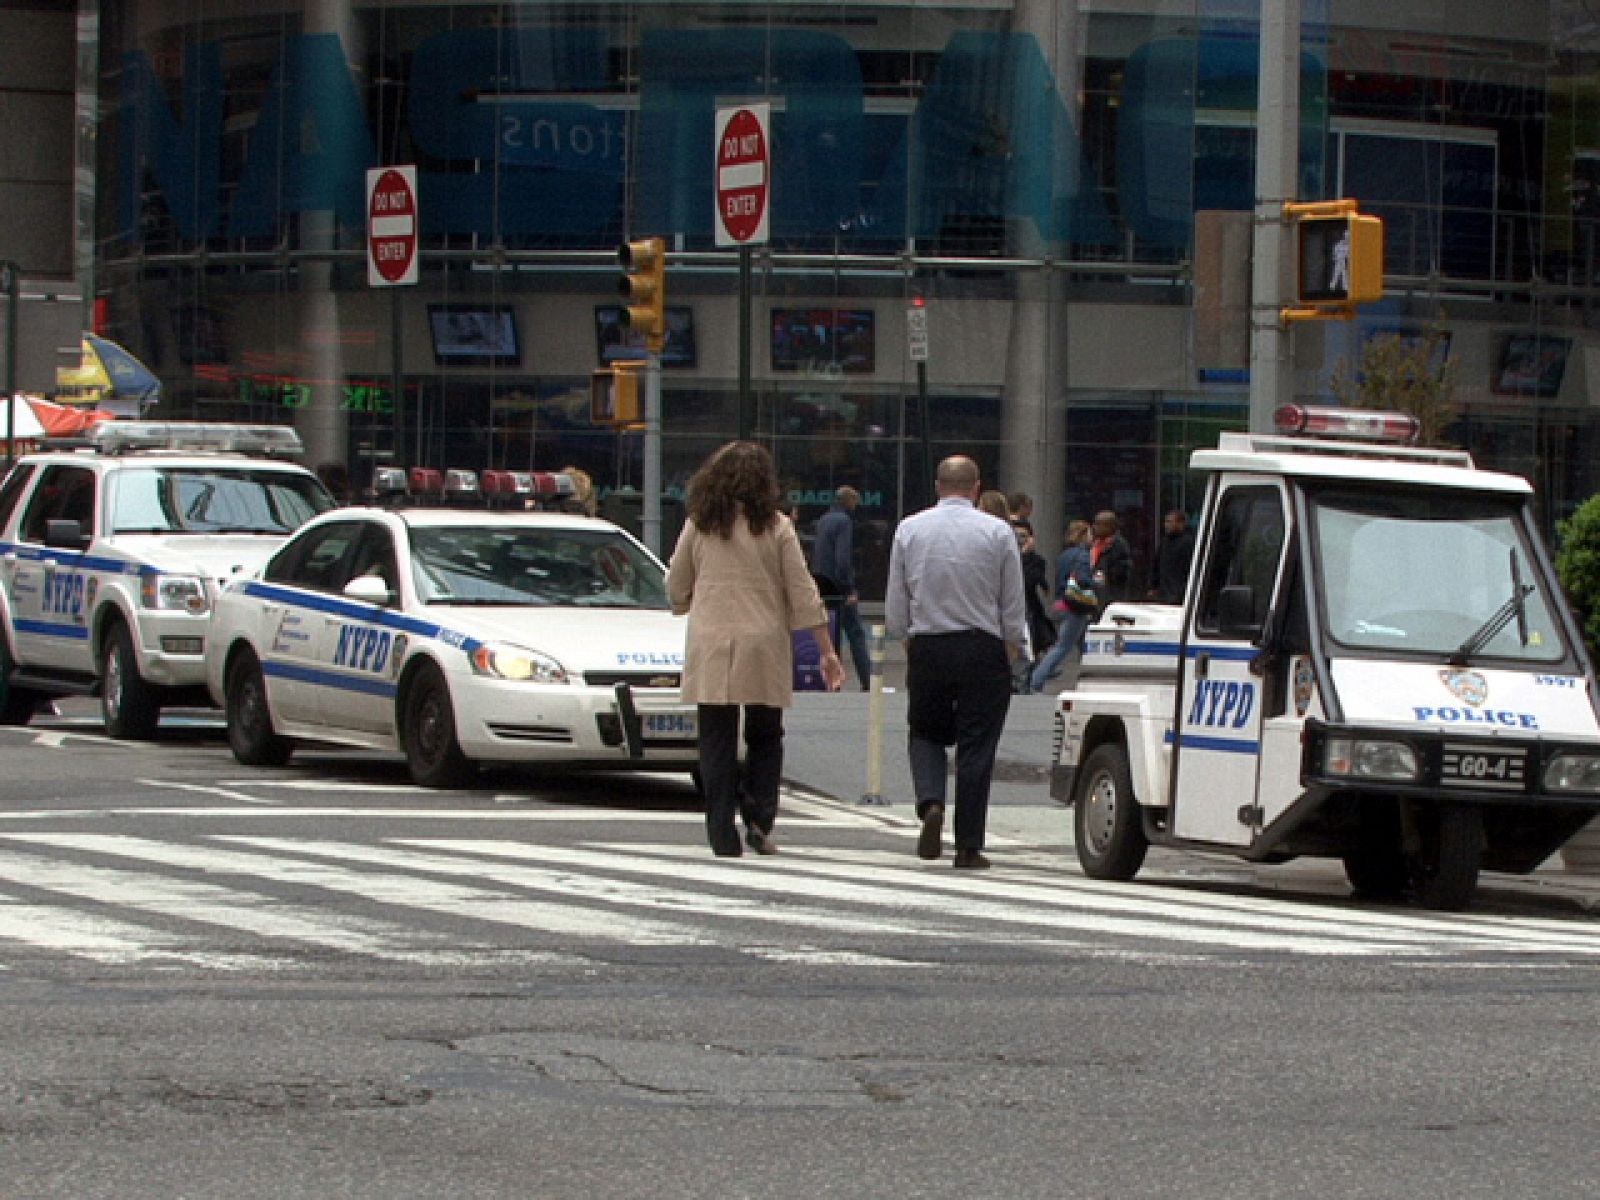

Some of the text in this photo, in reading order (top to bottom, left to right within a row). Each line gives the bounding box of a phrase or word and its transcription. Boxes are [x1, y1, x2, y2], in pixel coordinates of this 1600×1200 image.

[724, 134, 759, 158] DO NOT
[375, 190, 406, 211] DO NOT
[727, 194, 757, 218] ENTER
[377, 242, 406, 261] ENTER
[43, 572, 84, 614] NYPD
[333, 624, 391, 673] NYPD
[617, 652, 687, 666] POLIC
[1187, 679, 1254, 729] NYPD
[1412, 706, 1541, 731] POLICE
[1461, 754, 1506, 779] GO-4
